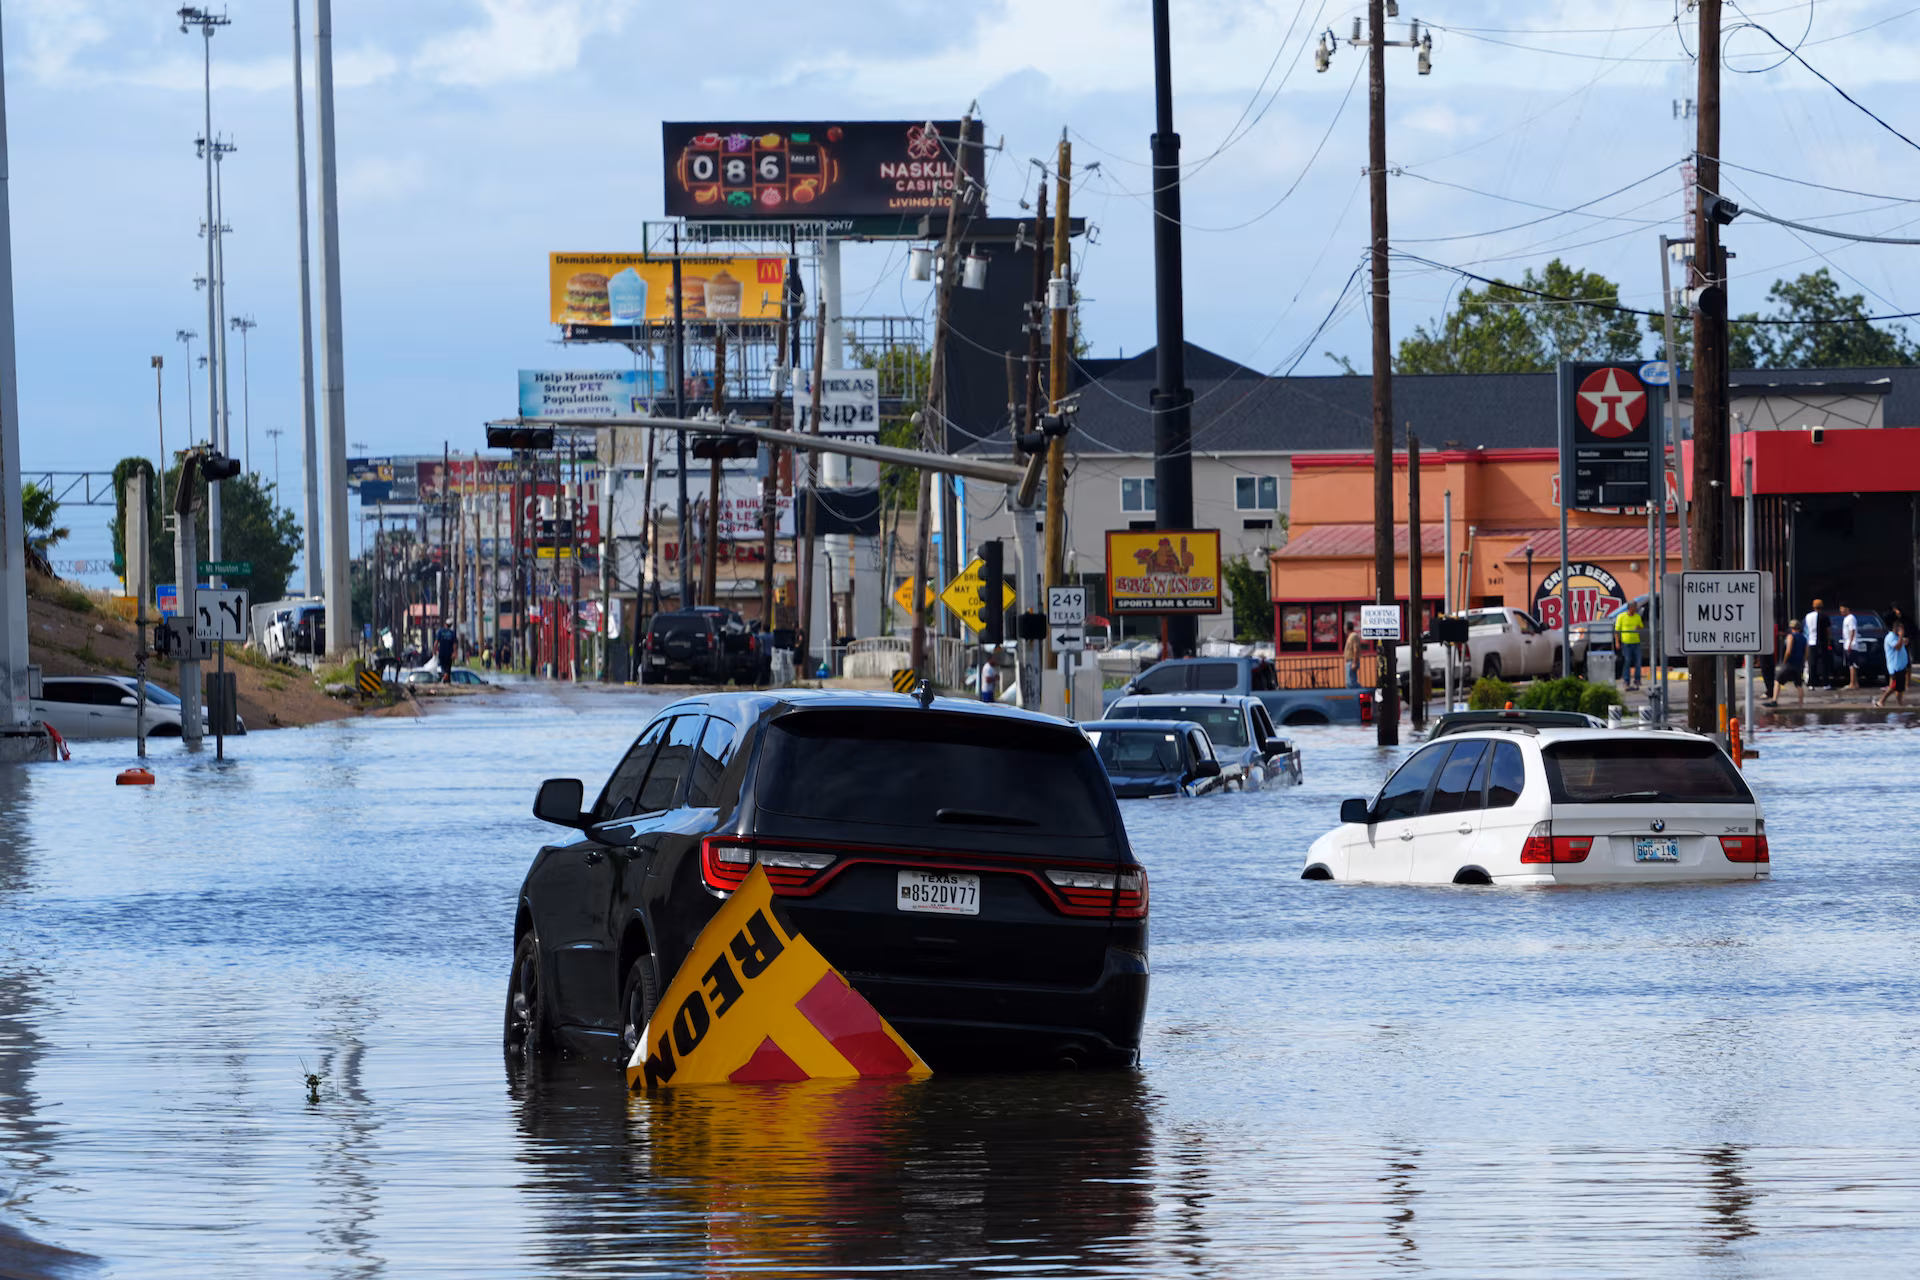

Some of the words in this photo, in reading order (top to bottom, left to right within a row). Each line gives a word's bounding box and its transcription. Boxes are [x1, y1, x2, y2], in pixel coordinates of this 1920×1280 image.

[881, 162, 954, 178] NASKIL
[889, 198, 954, 208] LIVINGSTO
[535, 372, 562, 383] Help
[565, 371, 623, 381] Houston's
[544, 384, 577, 393] Stray
[579, 382, 603, 392] PET
[215, 564, 239, 573] Houston
[1584, 565, 1616, 591] BEER
[955, 585, 970, 593] MAY
[1116, 576, 1215, 594] BREWINGZ
[1687, 582, 1720, 593] RIGHT
[1727, 582, 1756, 593] LANE
[1052, 594, 1082, 606] 249
[1118, 599, 1153, 607] SPORTS
[1155, 599, 1174, 607] BAR
[1176, 599, 1184, 607] &
[1187, 599, 1212, 607] GRILL
[1053, 612, 1081, 620] TEXAS
[1364, 609, 1395, 617] ROOFING
[1698, 604, 1744, 621] MUST
[1369, 617, 1398, 625] REPAIRS
[1687, 632, 1716, 643] TURN
[1723, 632, 1756, 643] RIGHT
[920, 874, 958, 884] TEXAS
[912, 884, 976, 905] 852DV77
